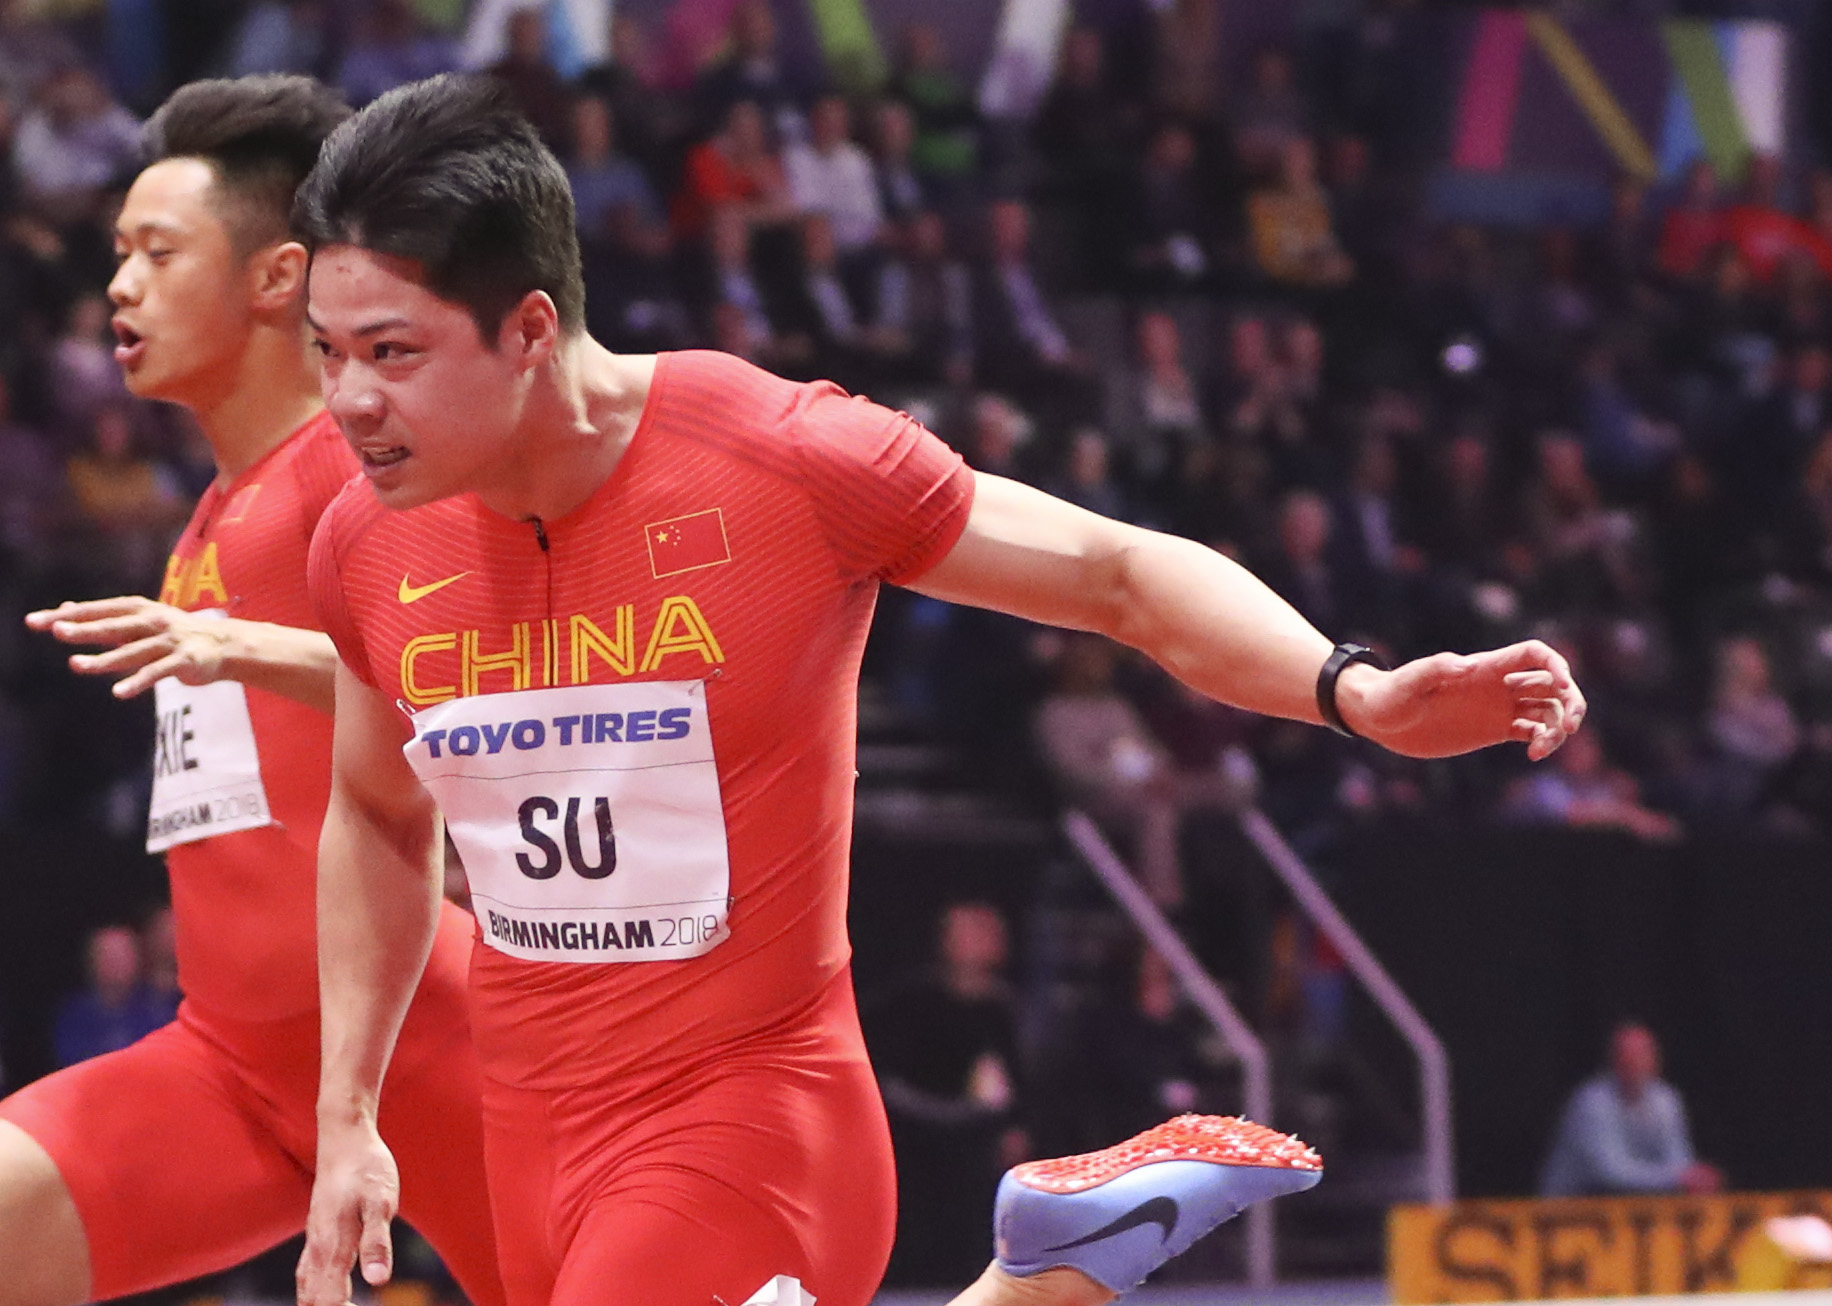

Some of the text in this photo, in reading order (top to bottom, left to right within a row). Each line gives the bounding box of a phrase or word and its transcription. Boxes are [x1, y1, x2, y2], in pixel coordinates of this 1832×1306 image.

[399, 595, 725, 705] CHINA
[421, 707, 692, 758] TOYO TIRES
[514, 795, 617, 881] SU
[488, 910, 719, 951] BIRMINGHAM 2018
[1434, 1200, 1828, 1304] SEIK
